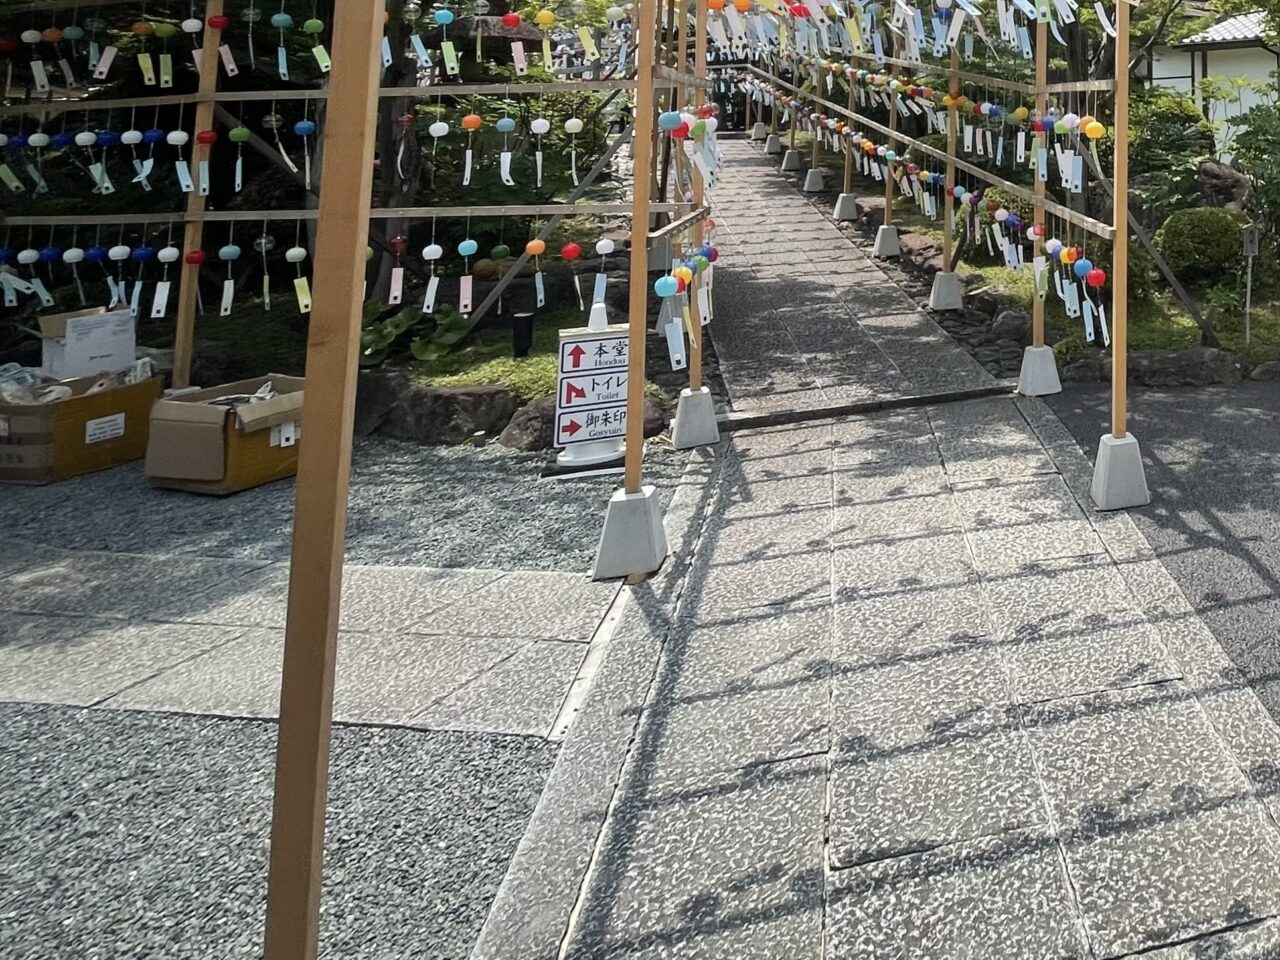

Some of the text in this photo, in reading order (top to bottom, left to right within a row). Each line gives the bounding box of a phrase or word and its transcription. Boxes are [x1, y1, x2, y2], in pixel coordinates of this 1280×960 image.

[593, 340, 628, 358] 本堂
[594, 358, 626, 367] Hondou
[591, 376, 627, 392] トイレ
[596, 392, 619, 401] Toilet
[585, 410, 627, 428] 御朱印
[588, 427, 622, 437] Gosyuin
